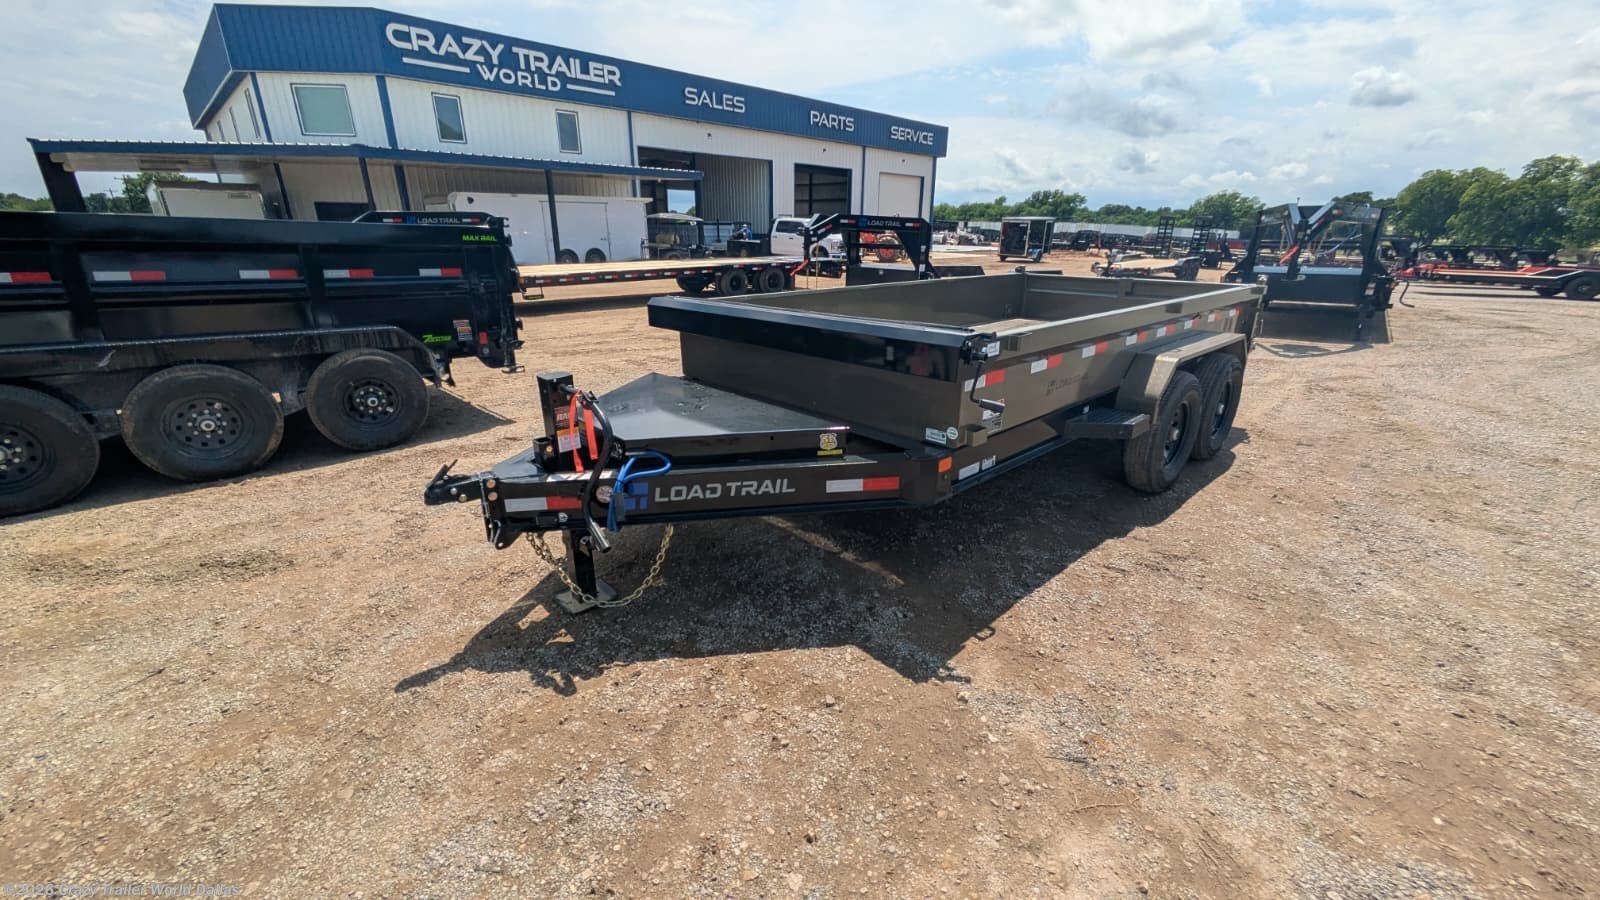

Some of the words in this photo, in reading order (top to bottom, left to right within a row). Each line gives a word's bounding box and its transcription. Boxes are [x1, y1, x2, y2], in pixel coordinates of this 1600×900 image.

[386, 22, 503, 65] CRAZY
[512, 46, 621, 87] TRAILER
[476, 63, 561, 92] WORLD
[684, 87, 746, 114] SALES
[810, 110, 855, 132] PARTS
[890, 126, 934, 145] SERVICE
[654, 483, 722, 503] LOAD
[726, 478, 796, 497] TRAIL
